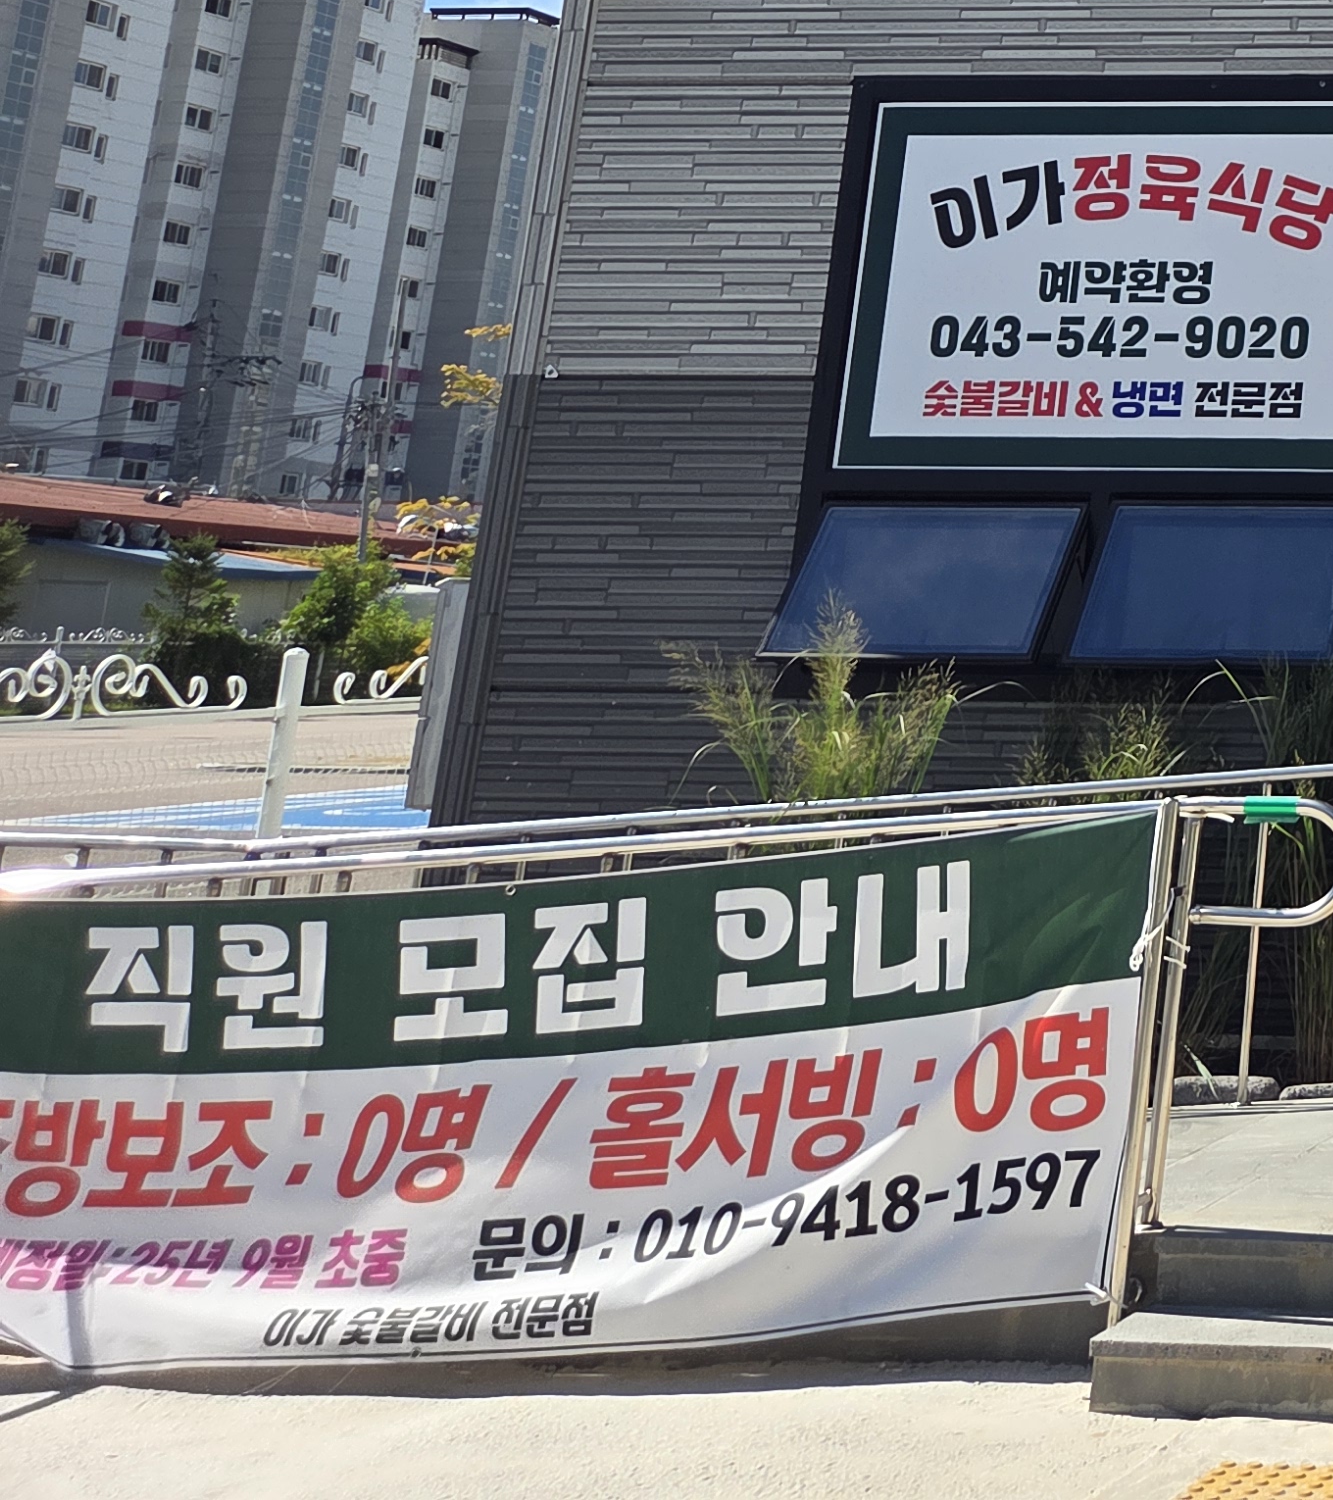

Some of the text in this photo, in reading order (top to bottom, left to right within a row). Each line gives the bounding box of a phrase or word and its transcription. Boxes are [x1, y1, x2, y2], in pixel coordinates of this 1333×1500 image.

[1038, 259, 1213, 304] 예약환영
[930, 316, 1309, 359] 043-542-9020
[922, 380, 1067, 418] 숯불갈비
[1111, 381, 1184, 418] 냉면
[1194, 381, 1303, 419] 전문점
[86, 860, 971, 1053] 직원 모집 안내
[337, 1083, 493, 1203] 0명
[495, 1078, 577, 1190] /
[589, 1048, 883, 1190] 홀서빙
[953, 1006, 1109, 1133] 0명
[471, 1212, 584, 1281] 문의
[633, 1149, 1102, 1263] 010-9418-1597
[232, 1234, 314, 1290] 9월
[314, 1227, 408, 1288] 초중
[263, 1291, 600, 1346] 이가 숯불갈비 전문점
